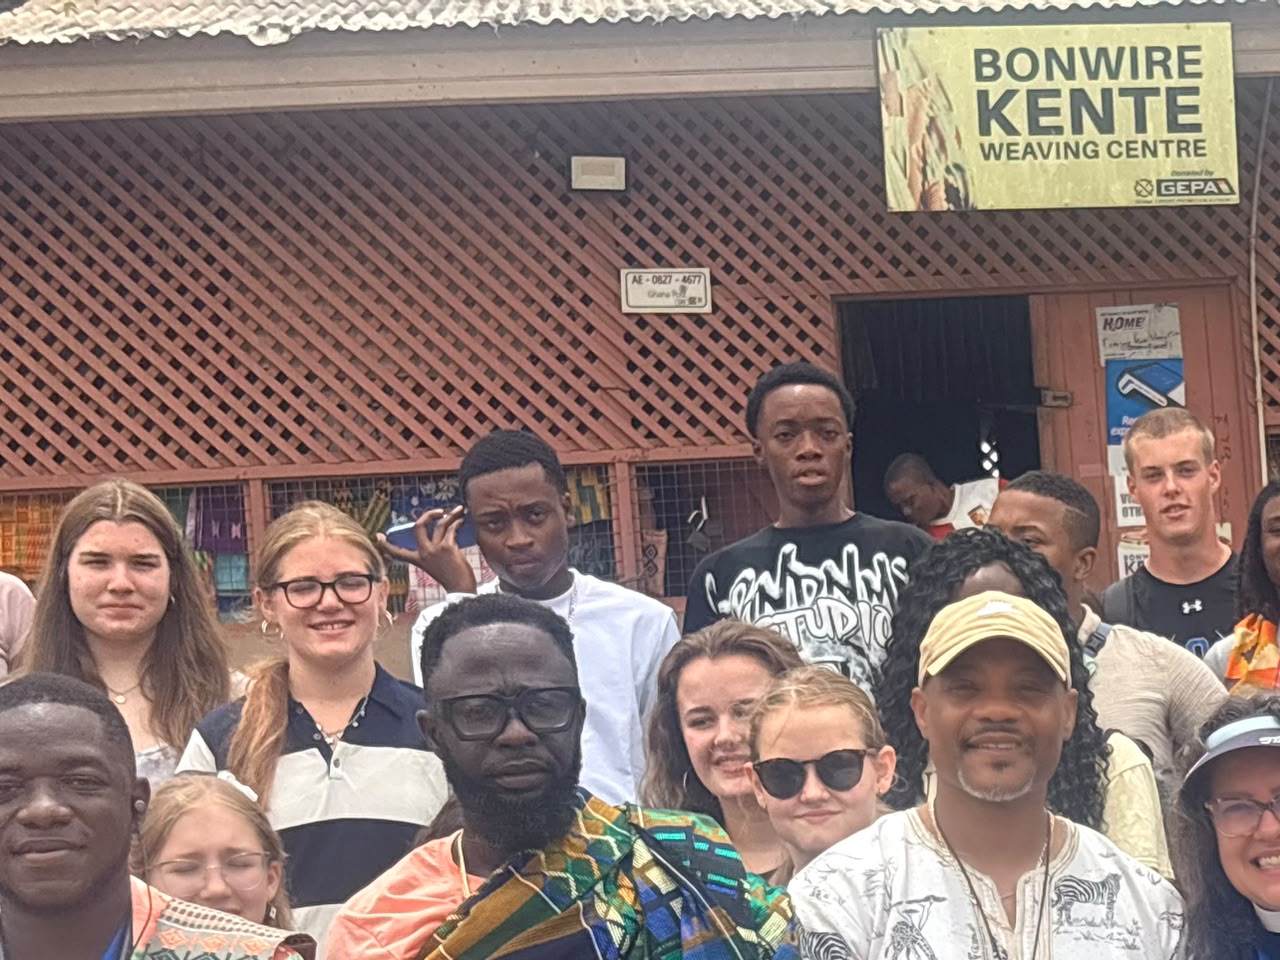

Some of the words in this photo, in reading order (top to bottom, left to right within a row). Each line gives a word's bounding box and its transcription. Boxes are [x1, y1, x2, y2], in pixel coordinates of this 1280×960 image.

[974, 45, 1204, 83] BONWIRE
[976, 86, 1203, 136] KENTE
[979, 141, 1100, 161] WEAVING
[1106, 139, 1208, 159] CENTRE
[1160, 180, 1219, 195] GEPA
